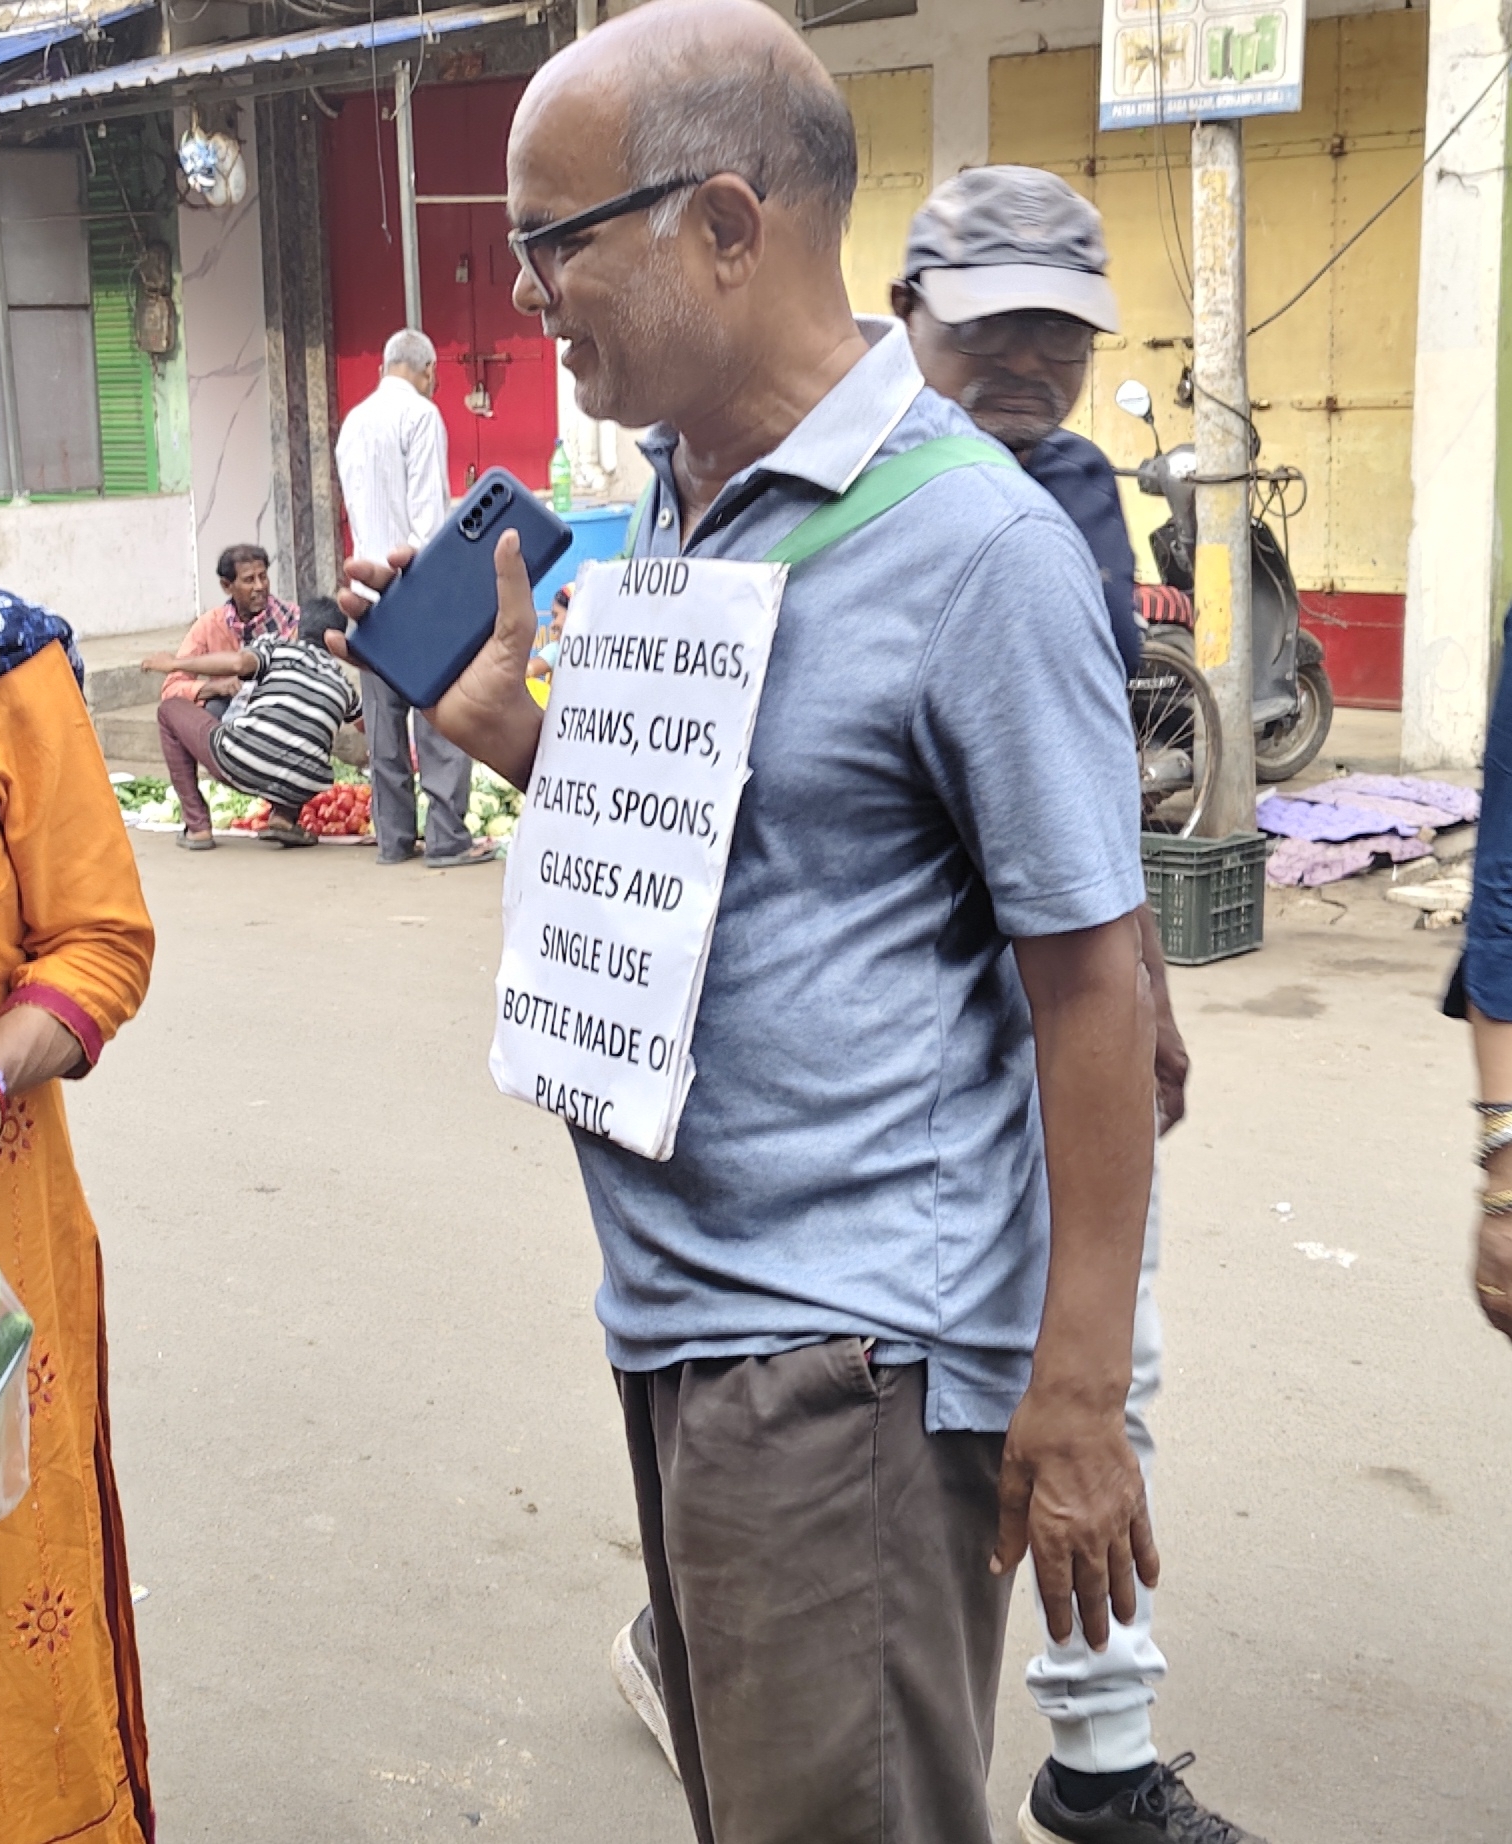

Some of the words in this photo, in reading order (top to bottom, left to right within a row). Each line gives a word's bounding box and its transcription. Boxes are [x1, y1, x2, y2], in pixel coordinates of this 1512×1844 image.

[619, 559, 689, 597] AVOID
[558, 633, 668, 673] POLYTHENE
[673, 638, 750, 689] BAGS,
[557, 705, 639, 756] STRAWS,
[649, 714, 721, 767] CUPS,
[533, 774, 601, 827] PLATES,
[608, 786, 719, 848] SPOONS,
[540, 849, 623, 900] GLASSES
[623, 867, 684, 911] AND
[540, 923, 602, 974] SINGLE
[607, 941, 653, 987] USE
[503, 987, 571, 1042] BOTTLE
[573, 1010, 642, 1065] MADE
[536, 1073, 614, 1138] PLASTIC
